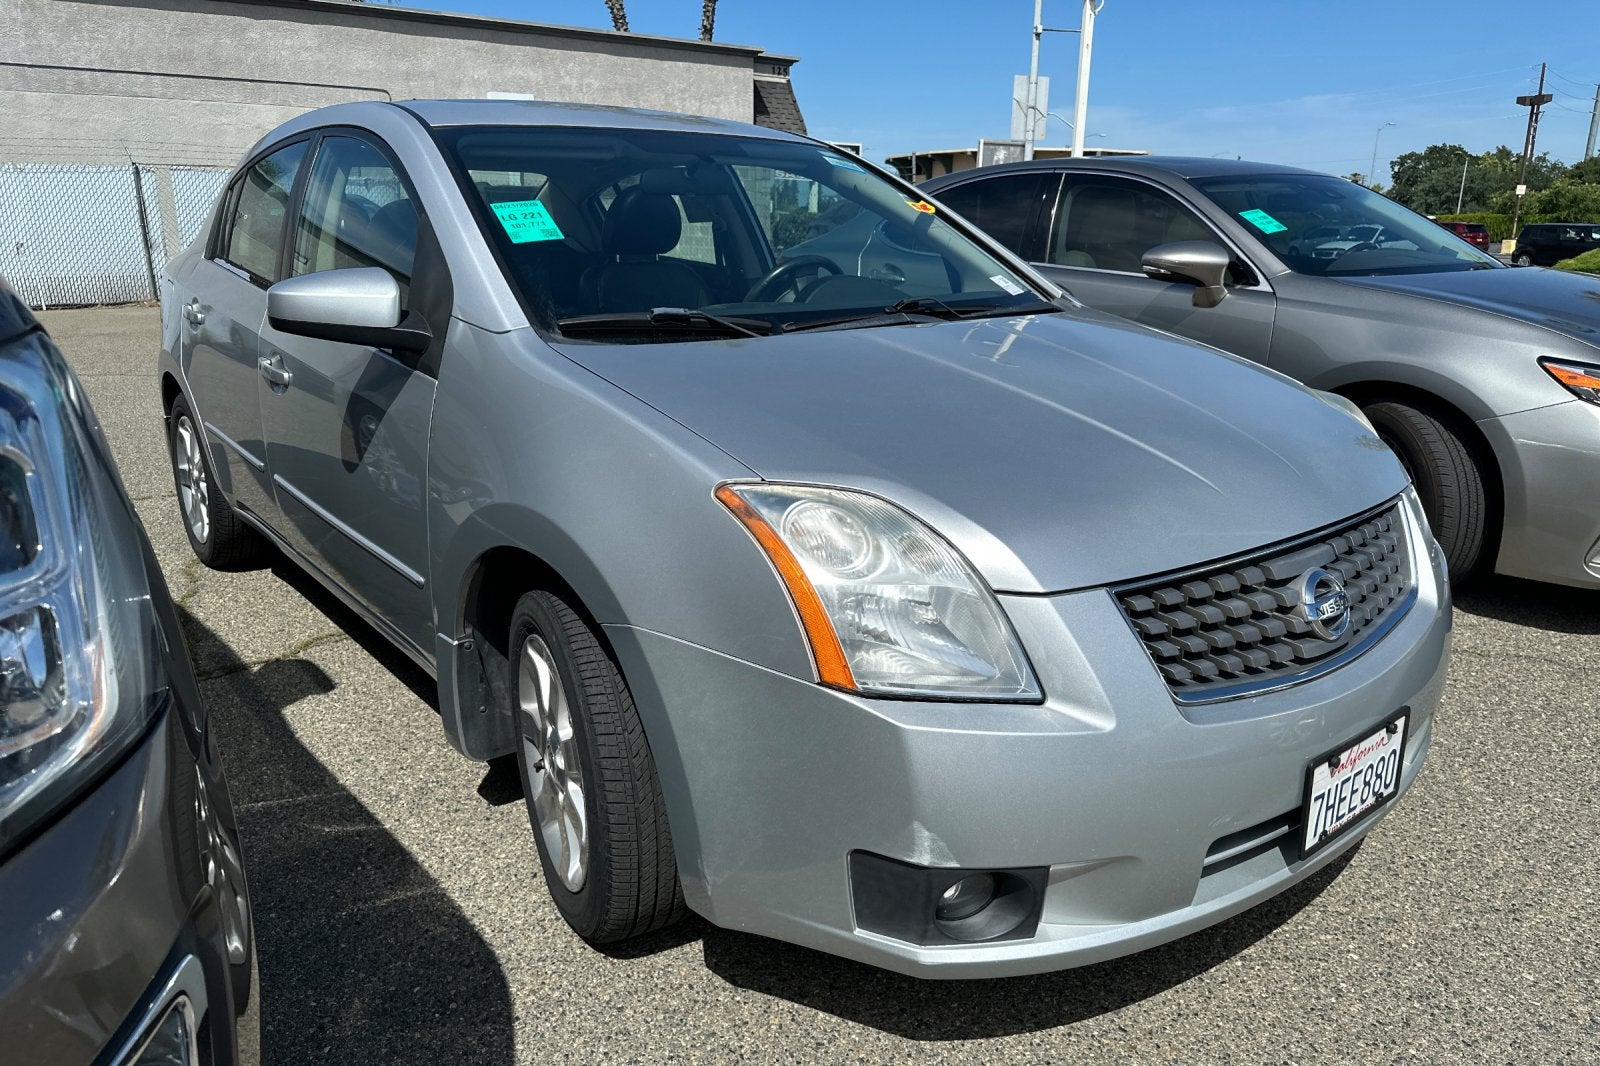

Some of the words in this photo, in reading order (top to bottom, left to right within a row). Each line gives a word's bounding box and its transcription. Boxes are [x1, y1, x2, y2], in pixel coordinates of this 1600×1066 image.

[500, 213, 518, 222] LG
[521, 211, 543, 220] 221
[1313, 748, 1397, 839] 7HEE880
